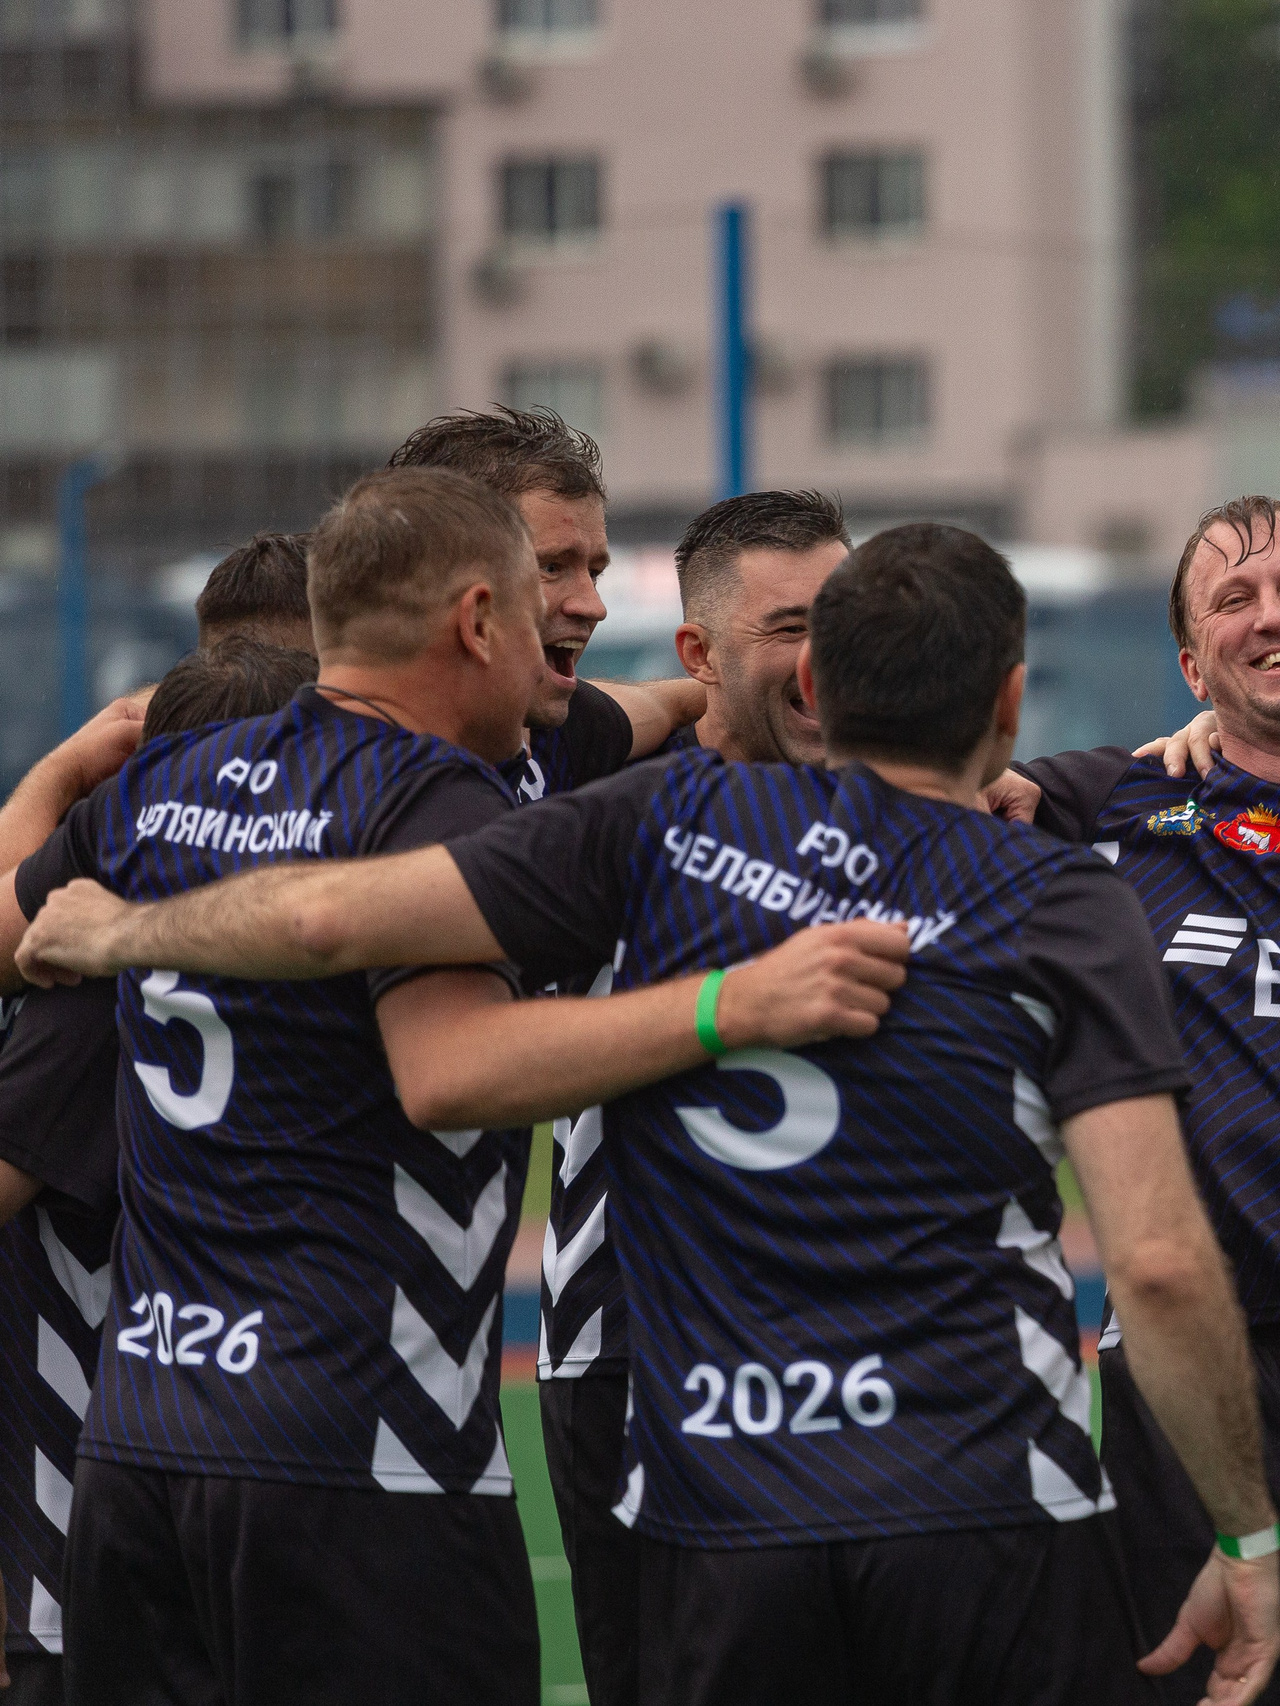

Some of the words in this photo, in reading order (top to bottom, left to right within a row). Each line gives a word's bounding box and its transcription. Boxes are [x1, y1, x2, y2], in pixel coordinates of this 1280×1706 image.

[134, 970, 235, 1130] 5
[117, 1291, 264, 1375] 2026
[681, 1354, 896, 1438] 2026
